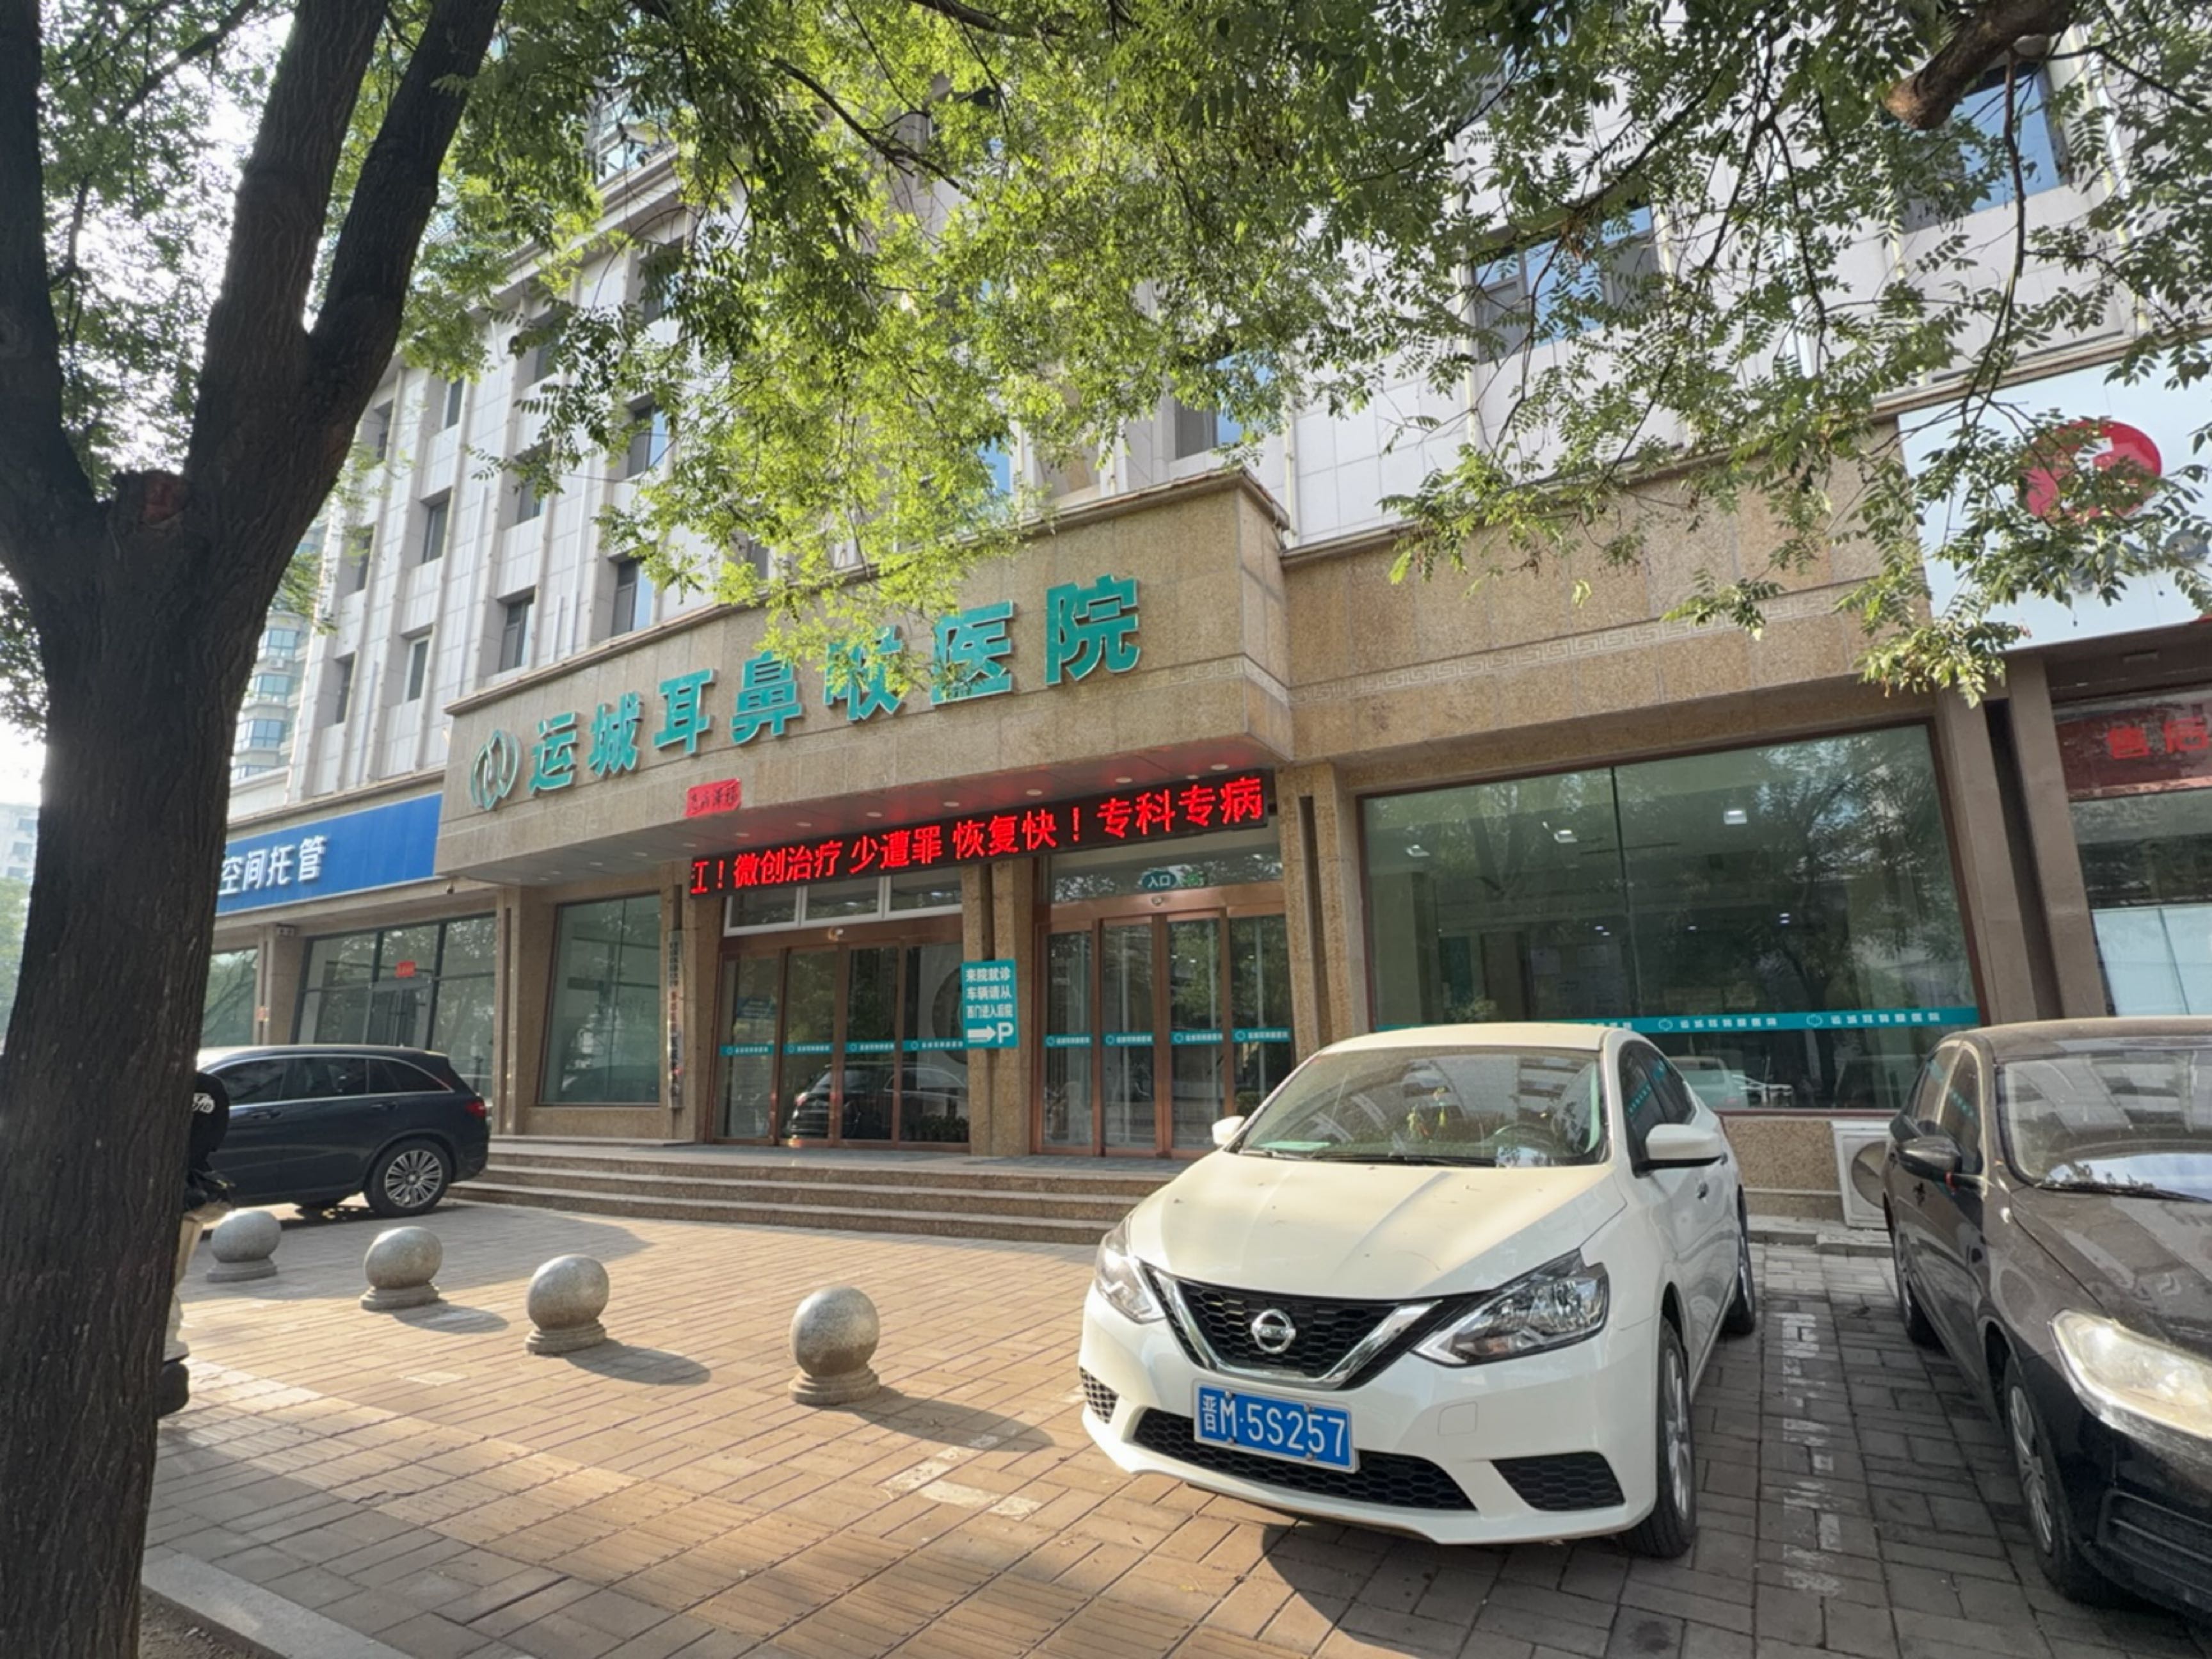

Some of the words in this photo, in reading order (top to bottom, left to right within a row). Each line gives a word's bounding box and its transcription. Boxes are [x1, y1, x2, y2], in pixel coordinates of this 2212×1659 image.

[528, 573, 1141, 795] 运城耳鼻喉医院
[217, 835, 328, 896] 空间托管
[849, 825, 942, 874] 少遭罪
[1147, 874, 1171, 888] 入口
[966, 984, 1013, 1000] 车辆请从
[997, 1022, 1014, 1045] P
